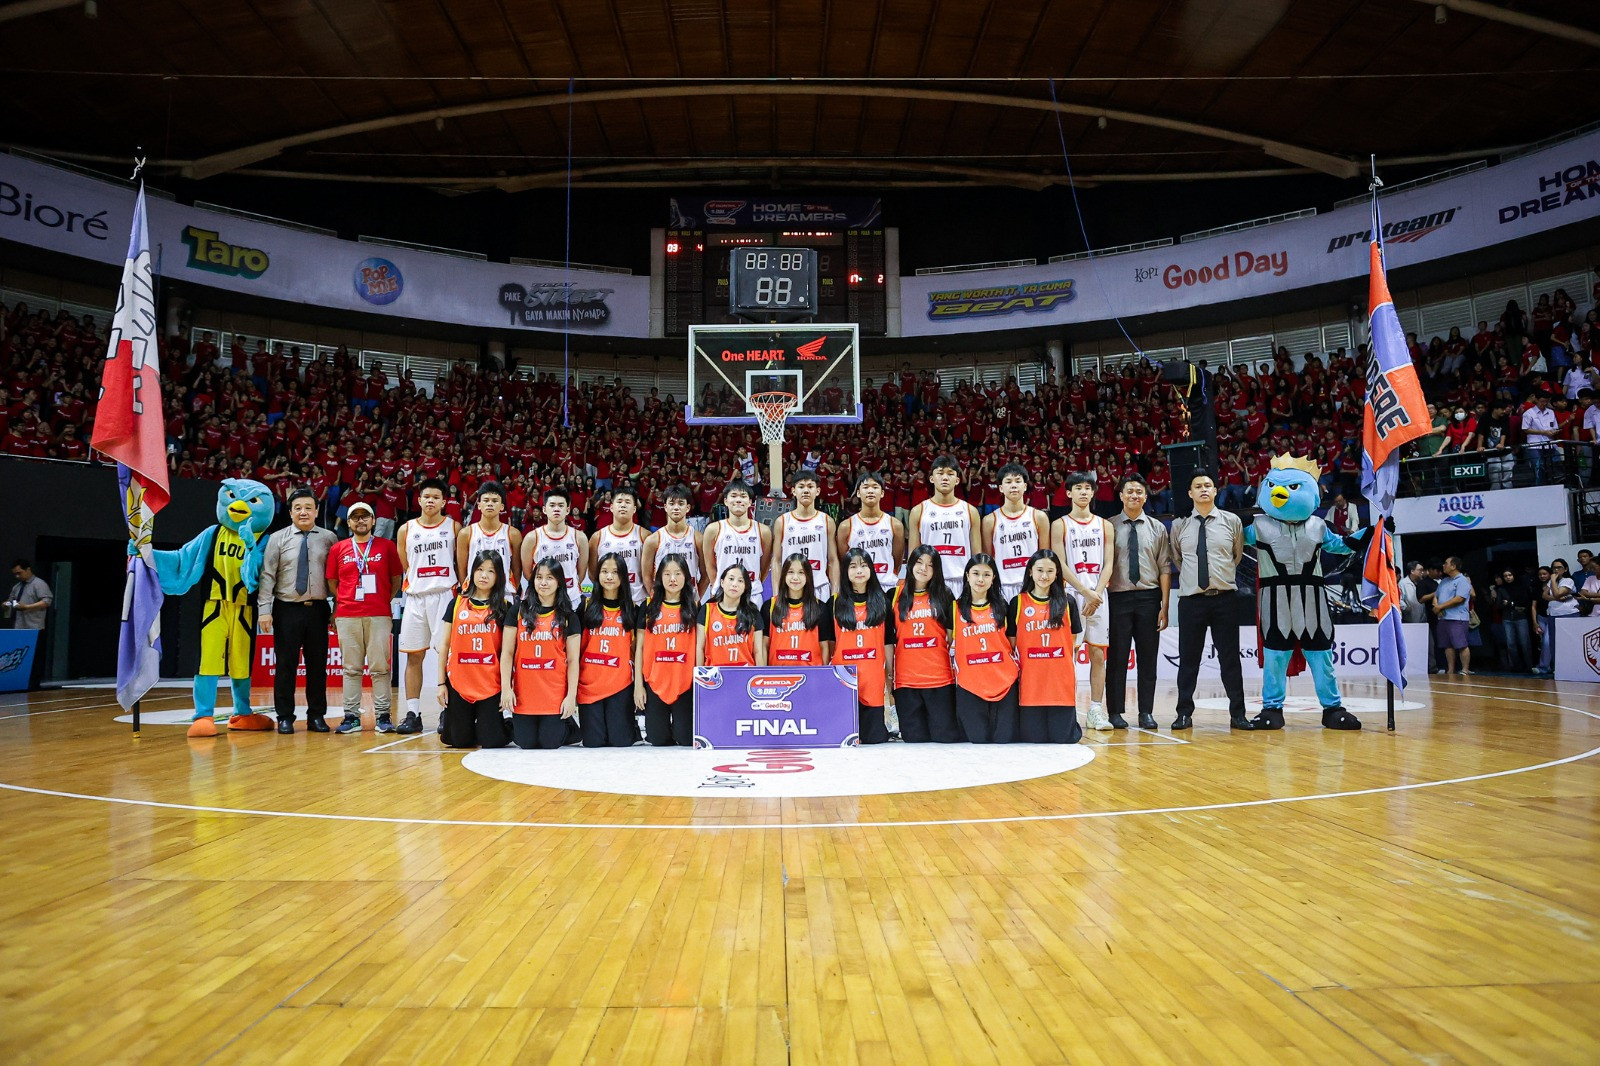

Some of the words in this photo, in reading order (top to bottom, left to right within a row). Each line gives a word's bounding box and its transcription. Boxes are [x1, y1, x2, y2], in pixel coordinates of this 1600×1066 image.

[0, 182, 108, 240] Bioré
[753, 204, 801, 212] HOME
[752, 213, 847, 221] DREAMERS
[184, 226, 269, 278] Taro
[361, 265, 388, 284] POP
[1163, 255, 1230, 290] Good
[1234, 251, 1288, 277] Day
[504, 292, 521, 302] PAKE
[930, 292, 961, 302] YANG
[962, 289, 1002, 299] WORTH
[1039, 281, 1072, 291] CUMA
[525, 310, 543, 321] GAYA
[546, 310, 571, 320] MAKIN
[721, 350, 744, 362] One
[746, 350, 785, 361] HEART.
[1454, 465, 1481, 476] EXIT
[1437, 494, 1485, 513] AQUA
[943, 533, 952, 544] 77
[414, 542, 443, 554] ST.LOUIS
[723, 546, 751, 555] ST.LOUIS
[1012, 545, 1022, 557] 13
[428, 554, 436, 566] 15
[1082, 551, 1087, 562] 3
[458, 623, 491, 635] ST.LOUIS
[912, 622, 925, 636] 22
[962, 623, 996, 637] ST.LOUIS
[472, 637, 483, 651] 13
[600, 639, 610, 653] 15
[666, 637, 676, 650] 14
[790, 635, 799, 648] 11
[856, 634, 864, 648] 8
[979, 637, 987, 651] 3
[1040, 633, 1050, 647] 17
[535, 644, 542, 658] 0
[727, 648, 739, 661] 77
[780, 702, 790, 711] Day
[735, 719, 818, 736] FINAL
